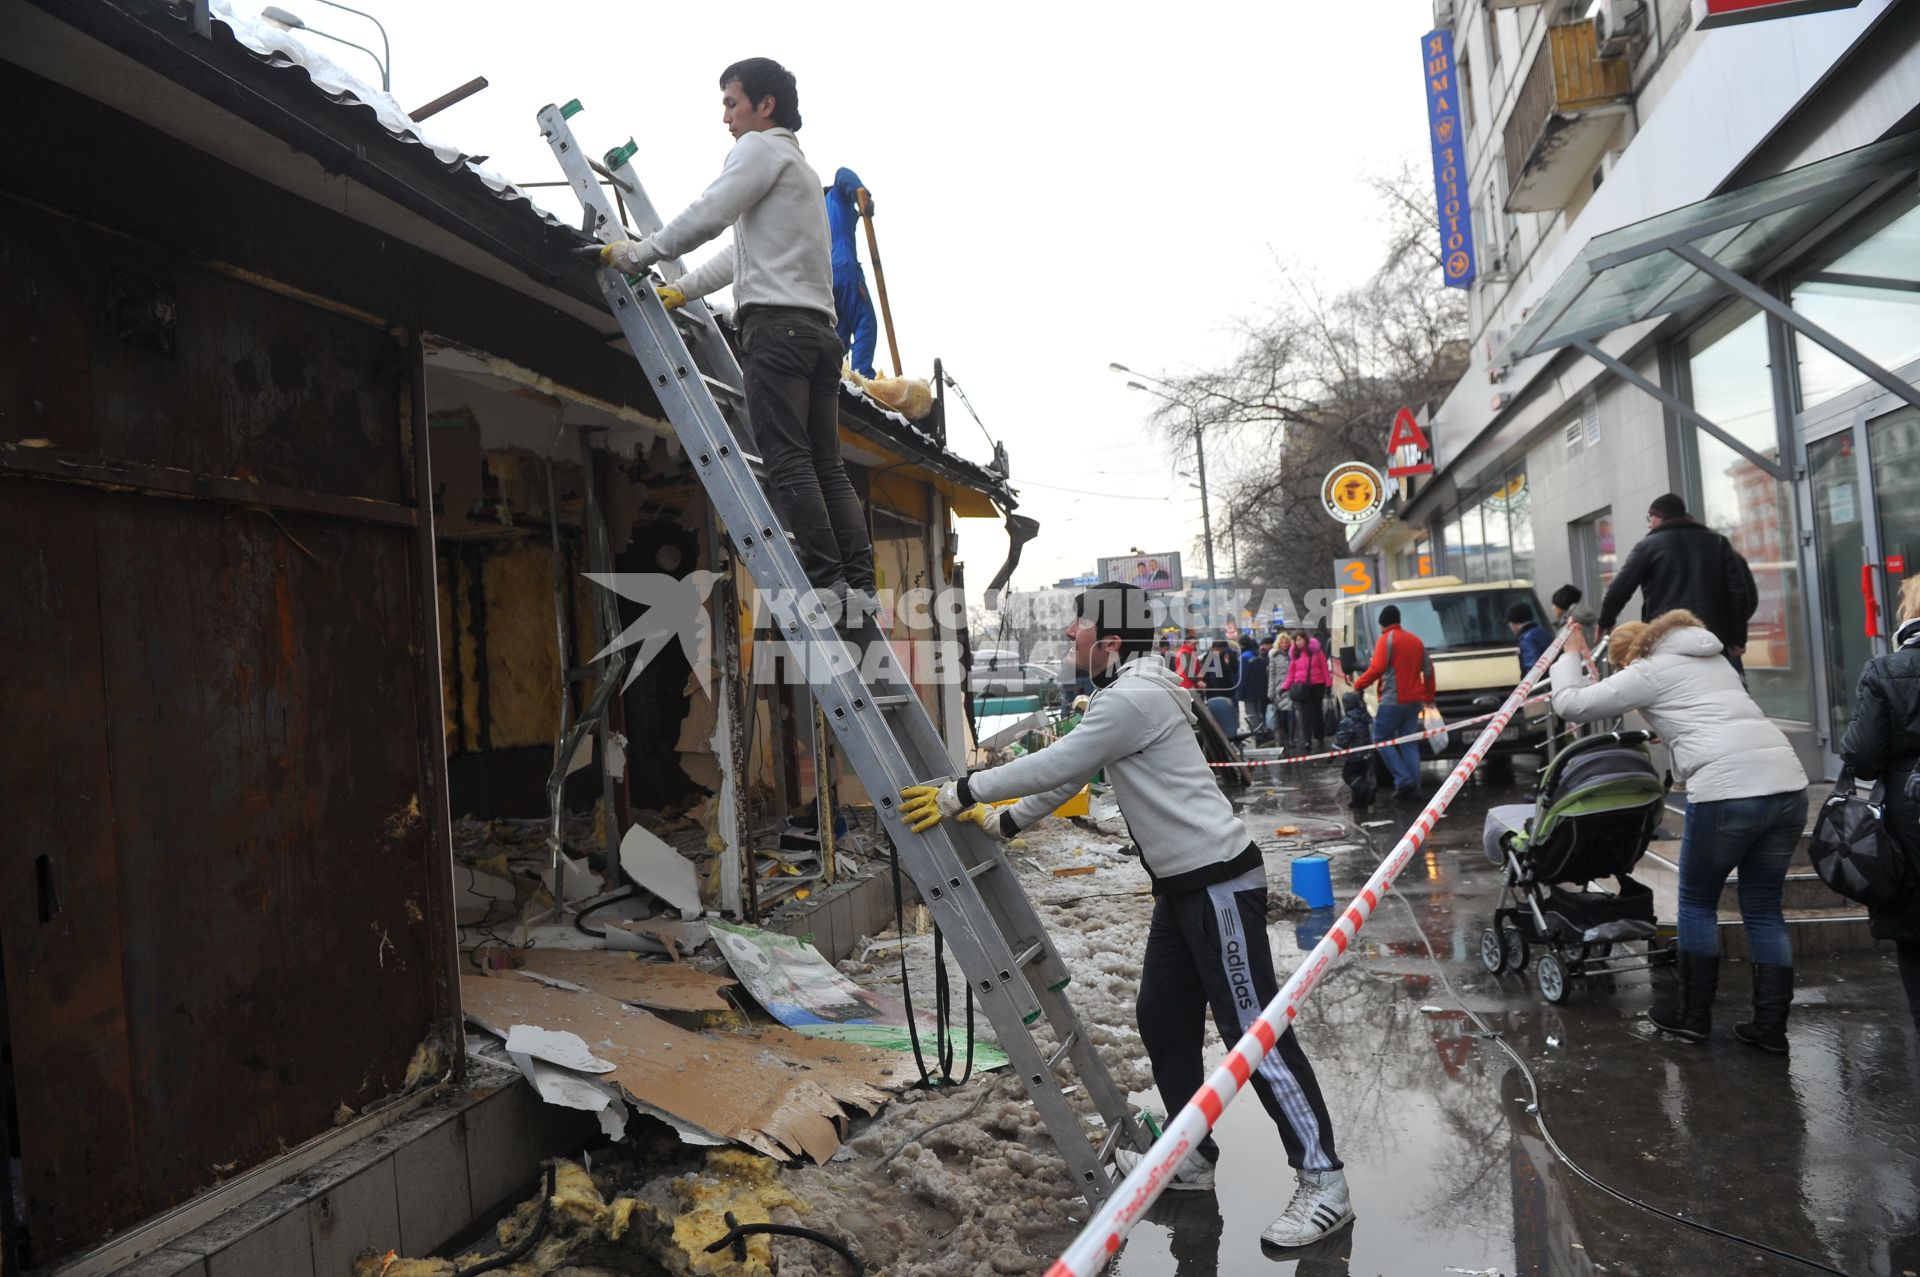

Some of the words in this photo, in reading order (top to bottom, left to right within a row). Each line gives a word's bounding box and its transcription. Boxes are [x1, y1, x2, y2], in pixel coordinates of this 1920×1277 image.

[1428, 35, 1449, 112] ЯШМА
[1441, 148, 1464, 250] ЗОЛОТО
[1226, 940, 1252, 1010] adidas
